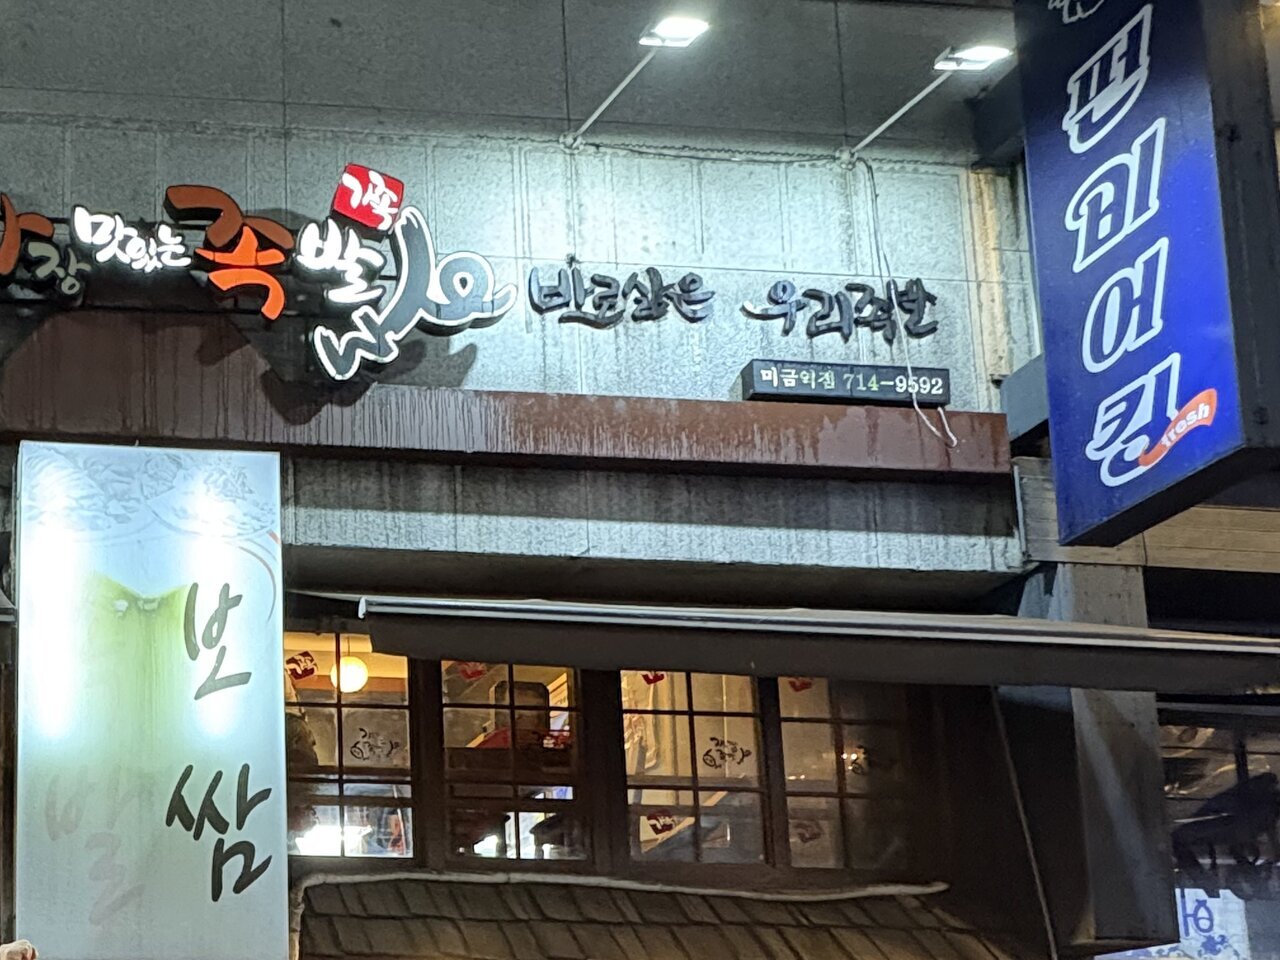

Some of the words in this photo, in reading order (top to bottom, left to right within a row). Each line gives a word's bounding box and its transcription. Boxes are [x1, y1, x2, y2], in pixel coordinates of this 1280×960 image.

[74, 206, 192, 273] 맛있는
[166, 184, 385, 321] 족발
[1062, 4, 1182, 487] 펀비어킹
[842, 372, 944, 395] 714-9592
[1161, 402, 1211, 447] fresh
